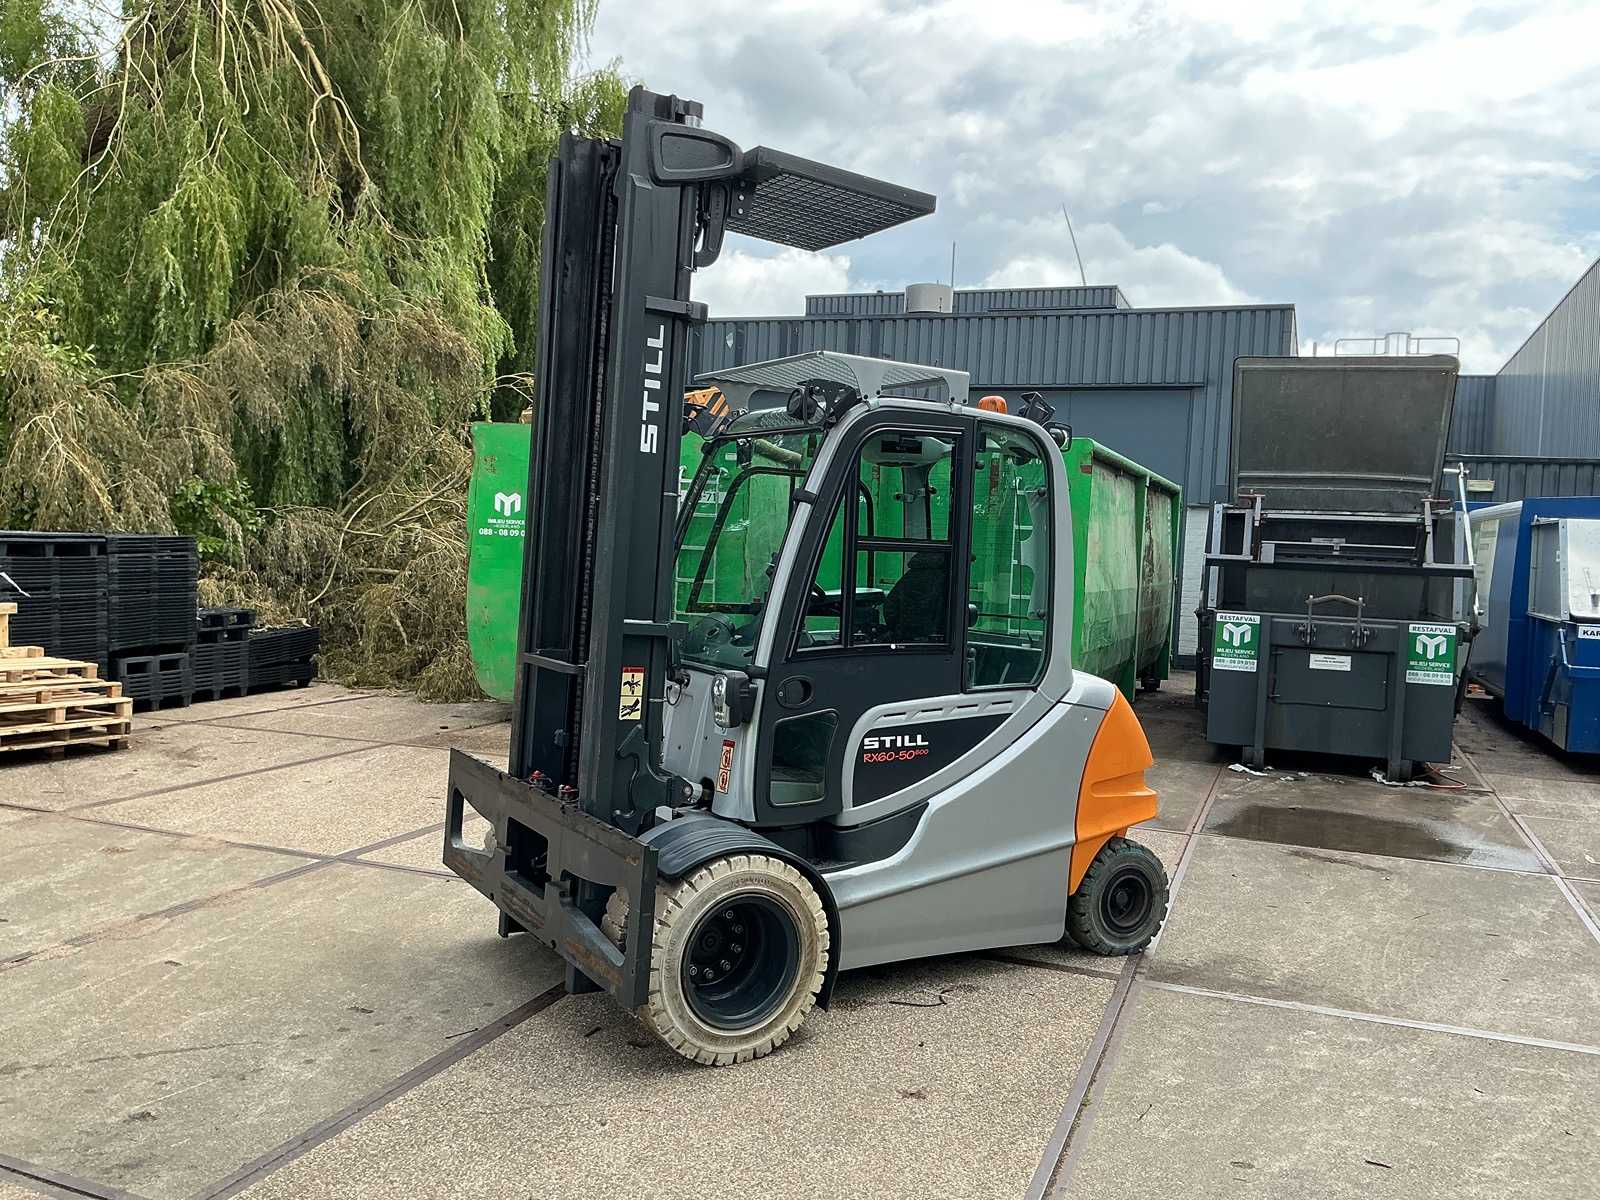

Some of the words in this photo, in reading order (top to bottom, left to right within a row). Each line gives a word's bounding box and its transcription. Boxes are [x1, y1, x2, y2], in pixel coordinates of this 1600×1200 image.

[640, 324, 665, 453] STILL
[478, 528, 493, 536] 088
[498, 528, 509, 536] 08
[509, 529, 519, 537] 09
[1219, 614, 1257, 623] RESTAFVAL
[1412, 625, 1452, 634] RESTAFVAL
[863, 734, 929, 749] STILL
